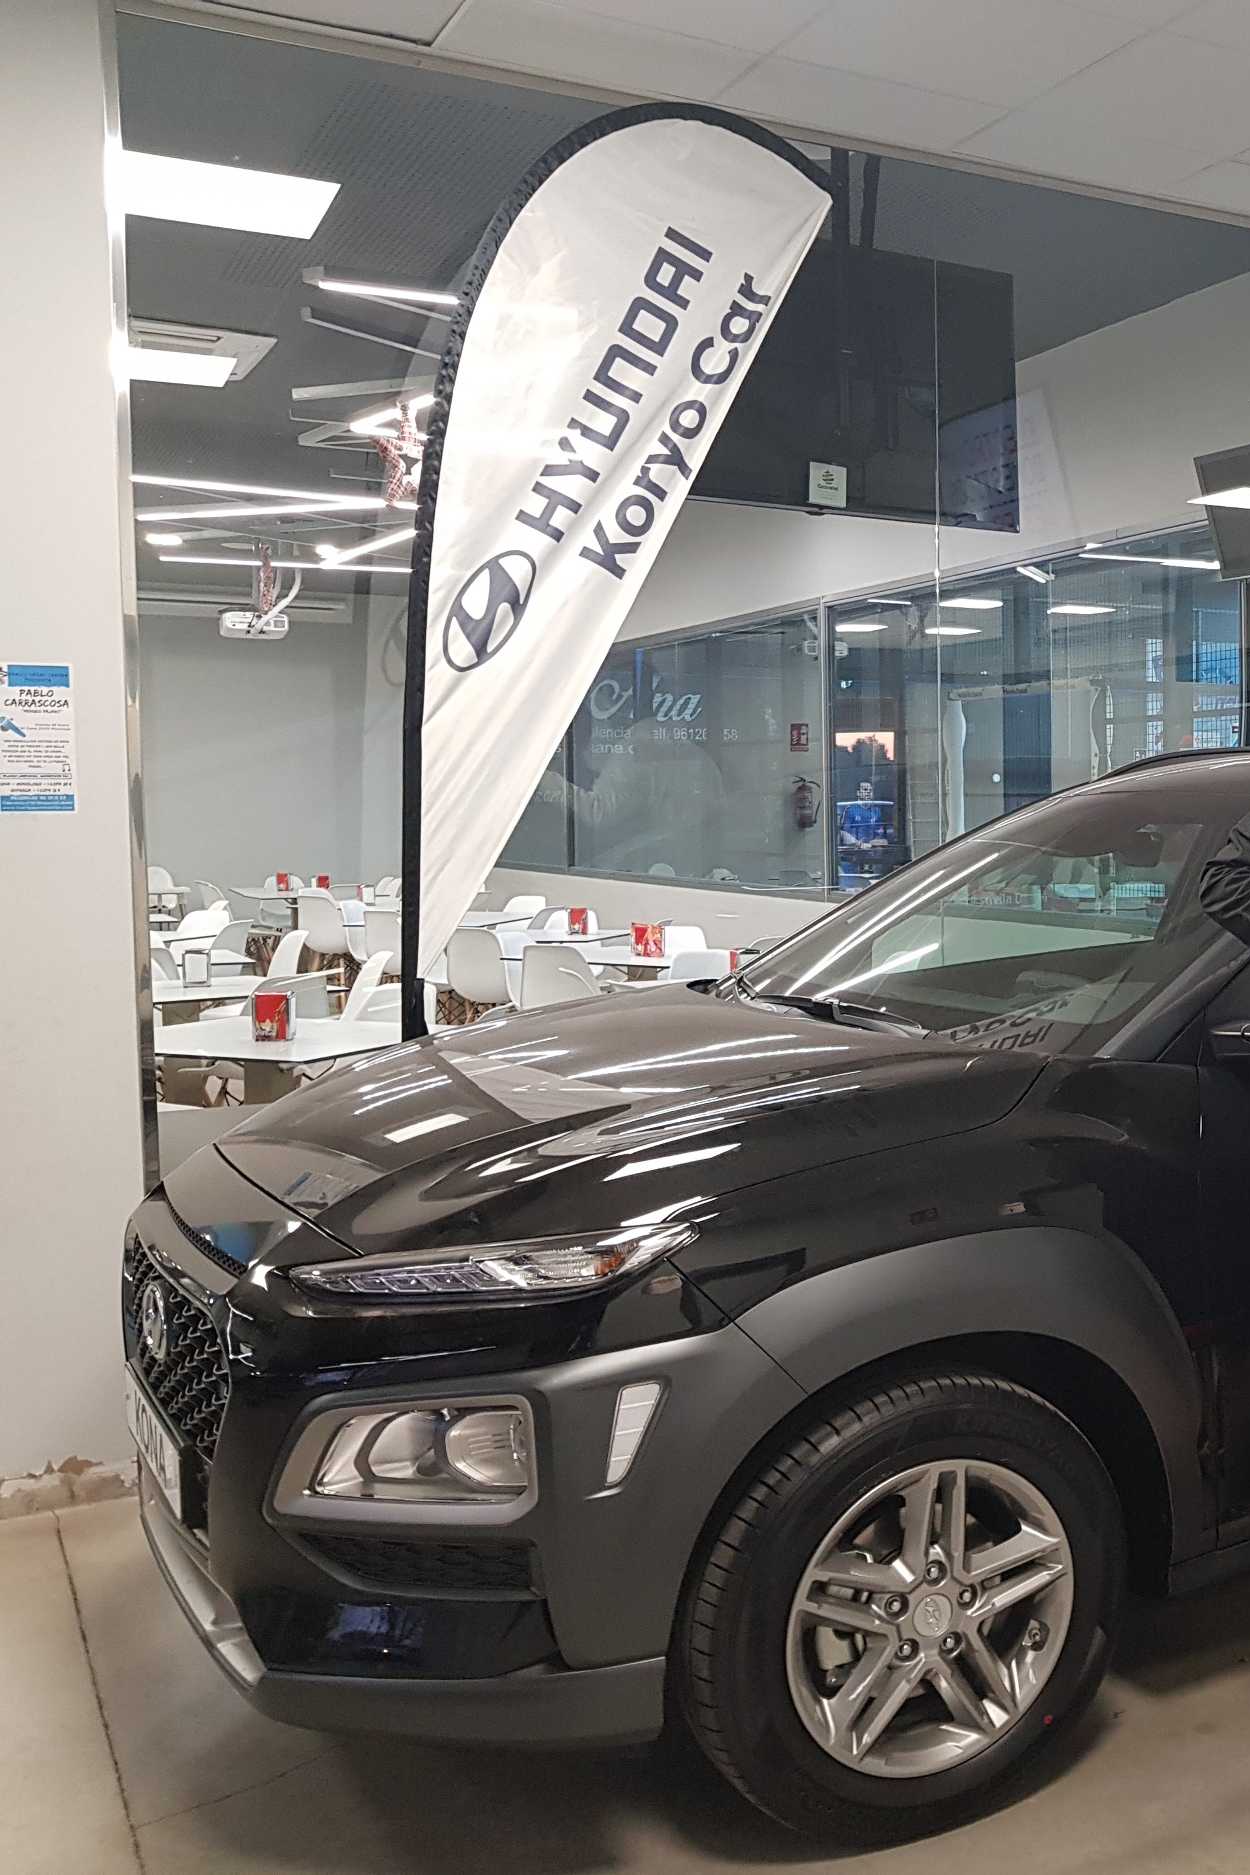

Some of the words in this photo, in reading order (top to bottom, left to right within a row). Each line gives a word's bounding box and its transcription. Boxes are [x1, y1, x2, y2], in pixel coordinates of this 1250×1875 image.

[515, 226, 713, 543] HYUNDAI
[579, 400, 708, 580] Koryo
[691, 272, 771, 385] Car
[4, 698, 69, 709] CARRASCOSA
[19, 689, 54, 698] PABLO
[134, 1389, 167, 1489] KONA
